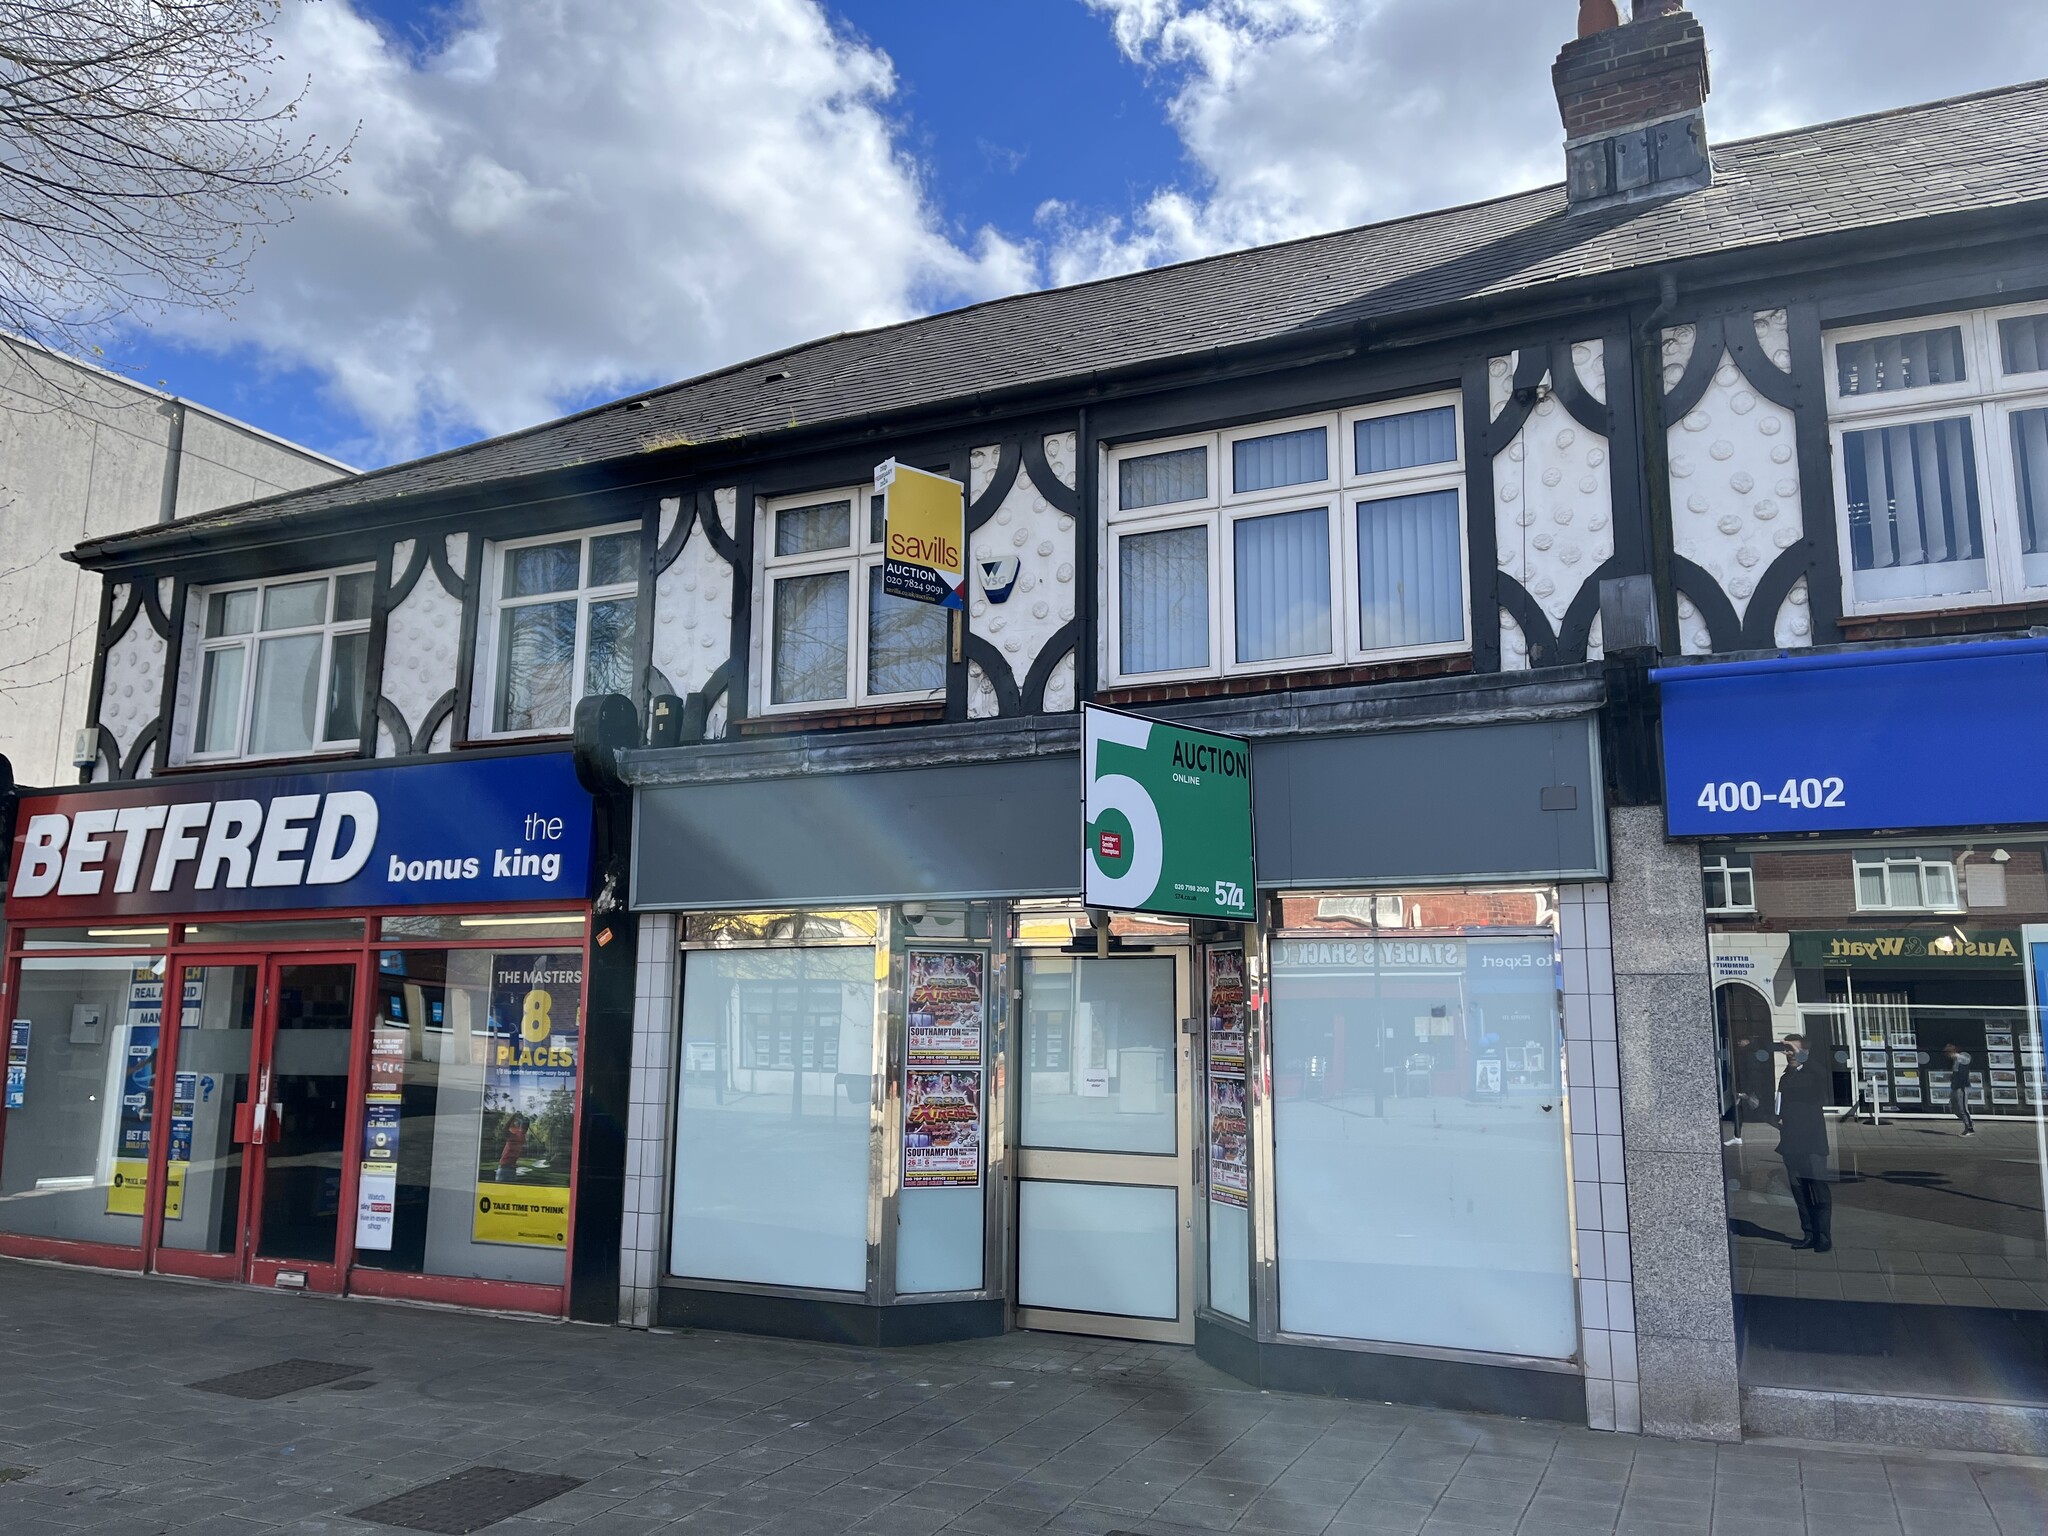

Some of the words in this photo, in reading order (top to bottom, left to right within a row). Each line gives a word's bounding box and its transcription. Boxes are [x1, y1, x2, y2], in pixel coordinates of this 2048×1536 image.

[891, 533, 958, 568] savills
[886, 563, 936, 582] AUCTION
[886, 576, 902, 585] 020
[904, 579, 924, 591] 7824
[925, 584, 943, 595] 9091
[985, 576, 1006, 586] VSG
[1173, 740, 1247, 779] AUCTION
[1172, 773, 1200, 786] ONLINE
[1697, 776, 1846, 812] 400-402
[1085, 706, 1163, 908] 5
[524, 812, 563, 841] the
[12, 790, 379, 898] BETFRED
[387, 854, 479, 883] bonus
[493, 849, 561, 882] king
[1215, 880, 1245, 910] 574
[498, 970, 521, 984] THE
[523, 970, 582, 984] MASTERS
[134, 987, 156, 999] REAL
[521, 989, 552, 1042] 8
[910, 1027, 961, 1036] SOUTHAMPTON
[496, 1046, 574, 1067] PLACES
[7, 1072, 26, 1085] 21?
[126, 1130, 141, 1140] BET
[907, 1148, 959, 1157] SOUTHAMPTON
[368, 1193, 385, 1201] Watch
[361, 1203, 370, 1211] sky
[493, 1202, 510, 1211] TAKE
[512, 1204, 528, 1212] TIME
[530, 1205, 540, 1213] TO
[541, 1206, 564, 1214] THINK
[360, 1213, 369, 1221] live
[376, 1215, 391, 1223] every
[368, 1222, 381, 1230] shop
